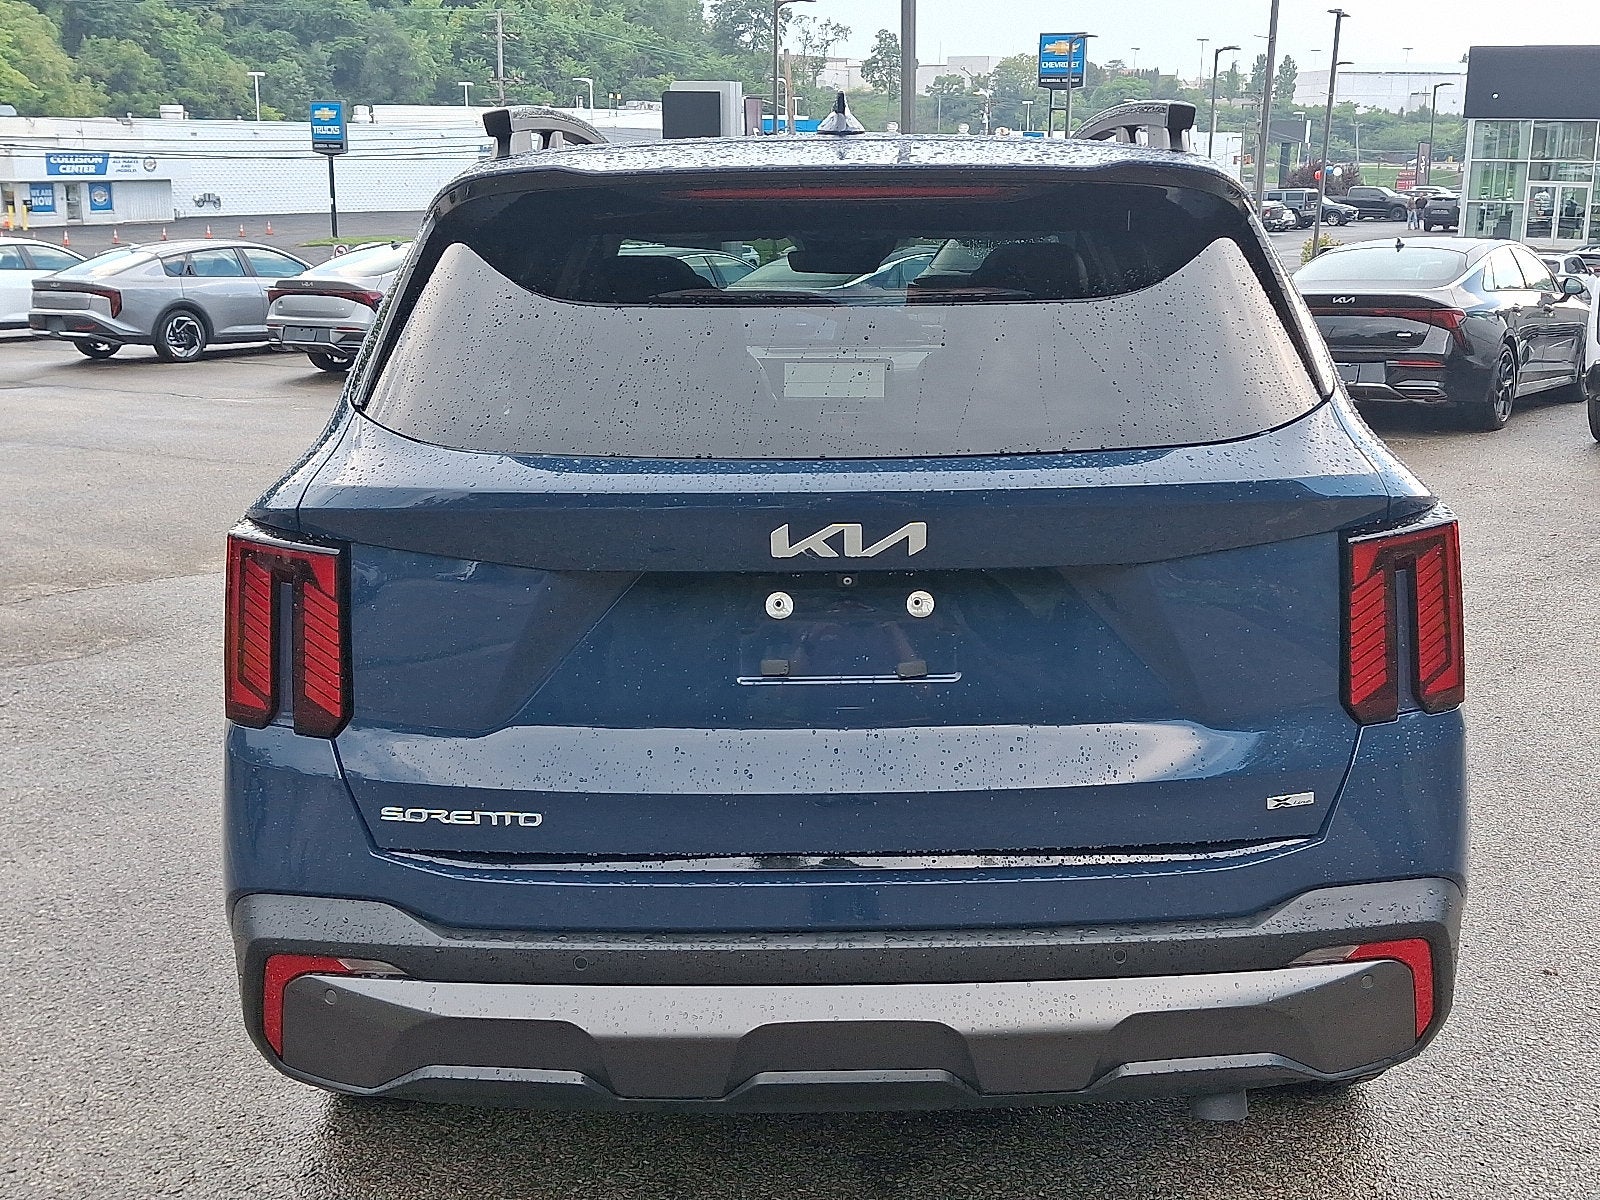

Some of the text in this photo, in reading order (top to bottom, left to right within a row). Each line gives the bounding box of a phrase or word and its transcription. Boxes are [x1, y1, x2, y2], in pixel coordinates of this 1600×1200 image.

[1041, 61, 1080, 69] CHEVROET
[312, 125, 340, 135] TRUCKS
[49, 154, 103, 164] COLLISION
[59, 164, 96, 174] CENTER
[31, 196, 52, 206] NOW
[1332, 296, 1356, 304] KIA
[770, 521, 928, 559] KIA
[380, 805, 543, 827] SORENTO
